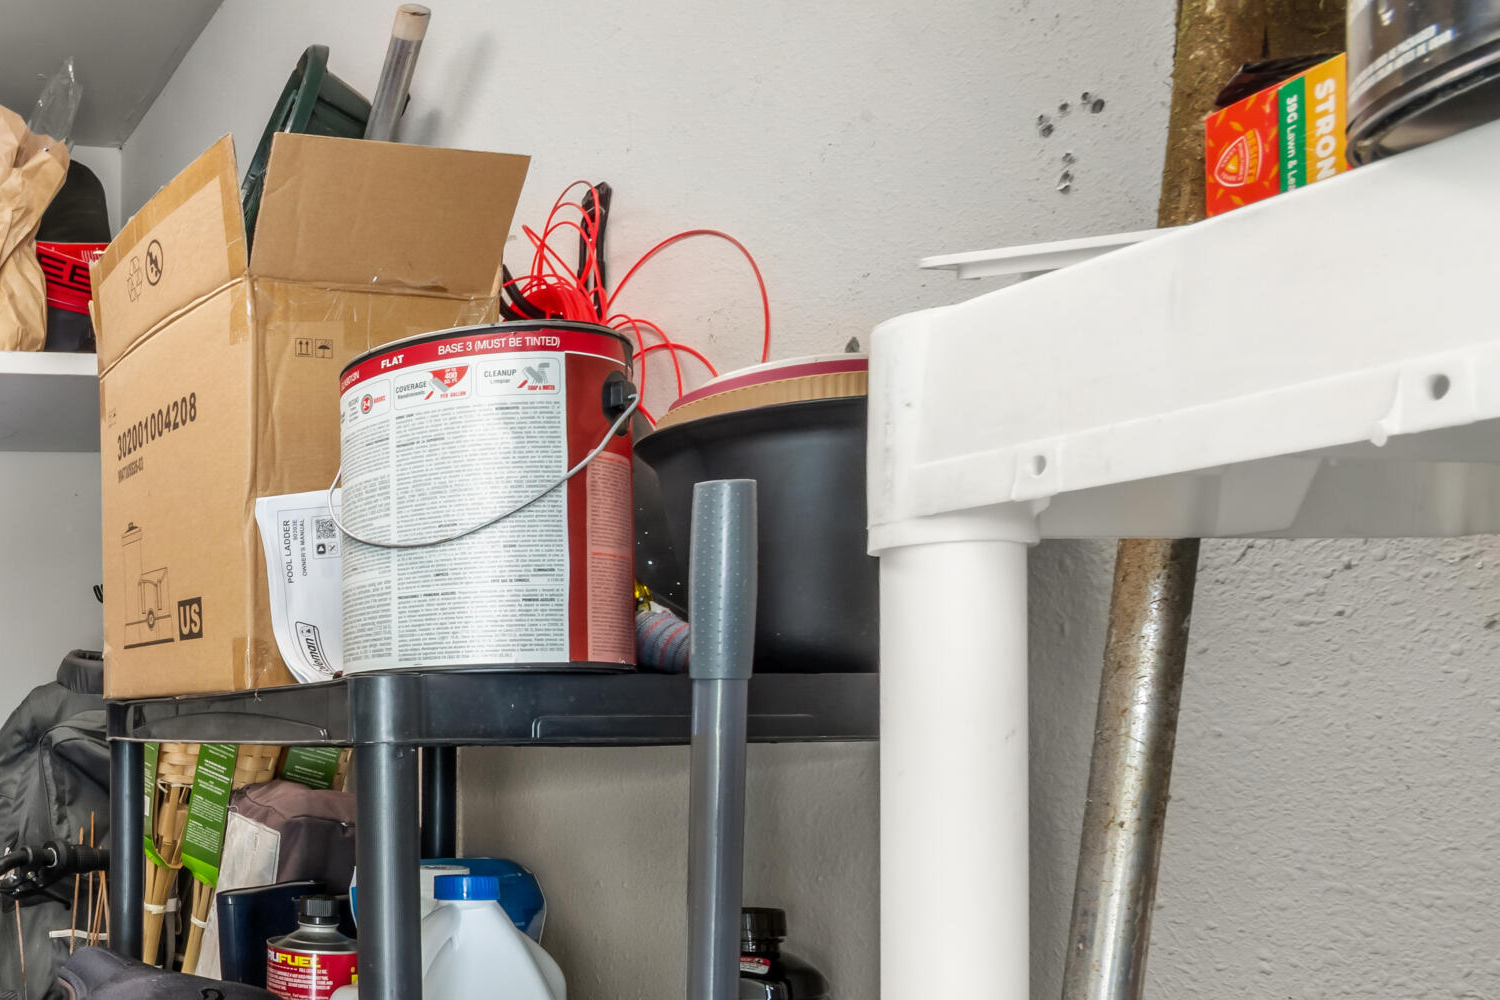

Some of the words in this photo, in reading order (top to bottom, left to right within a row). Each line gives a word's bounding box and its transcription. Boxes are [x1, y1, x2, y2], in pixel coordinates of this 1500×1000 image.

[1287, 124, 1297, 158] Lawn
[1315, 78, 1336, 180] STRON
[380, 354, 404, 370] FLAT
[437, 342, 465, 356] BASE
[466, 341, 473, 352] 3
[474, 337, 507, 352] (MUST
[508, 336, 522, 348] BE
[524, 335, 561, 348] TINTED)
[395, 380, 428, 394] COVERAGE
[483, 368, 517, 378] CLEANUP
[117, 392, 197, 461] 302001004208
[282, 519, 292, 557] LADDER
[286, 558, 295, 585] POOL
[179, 602, 202, 638] US
